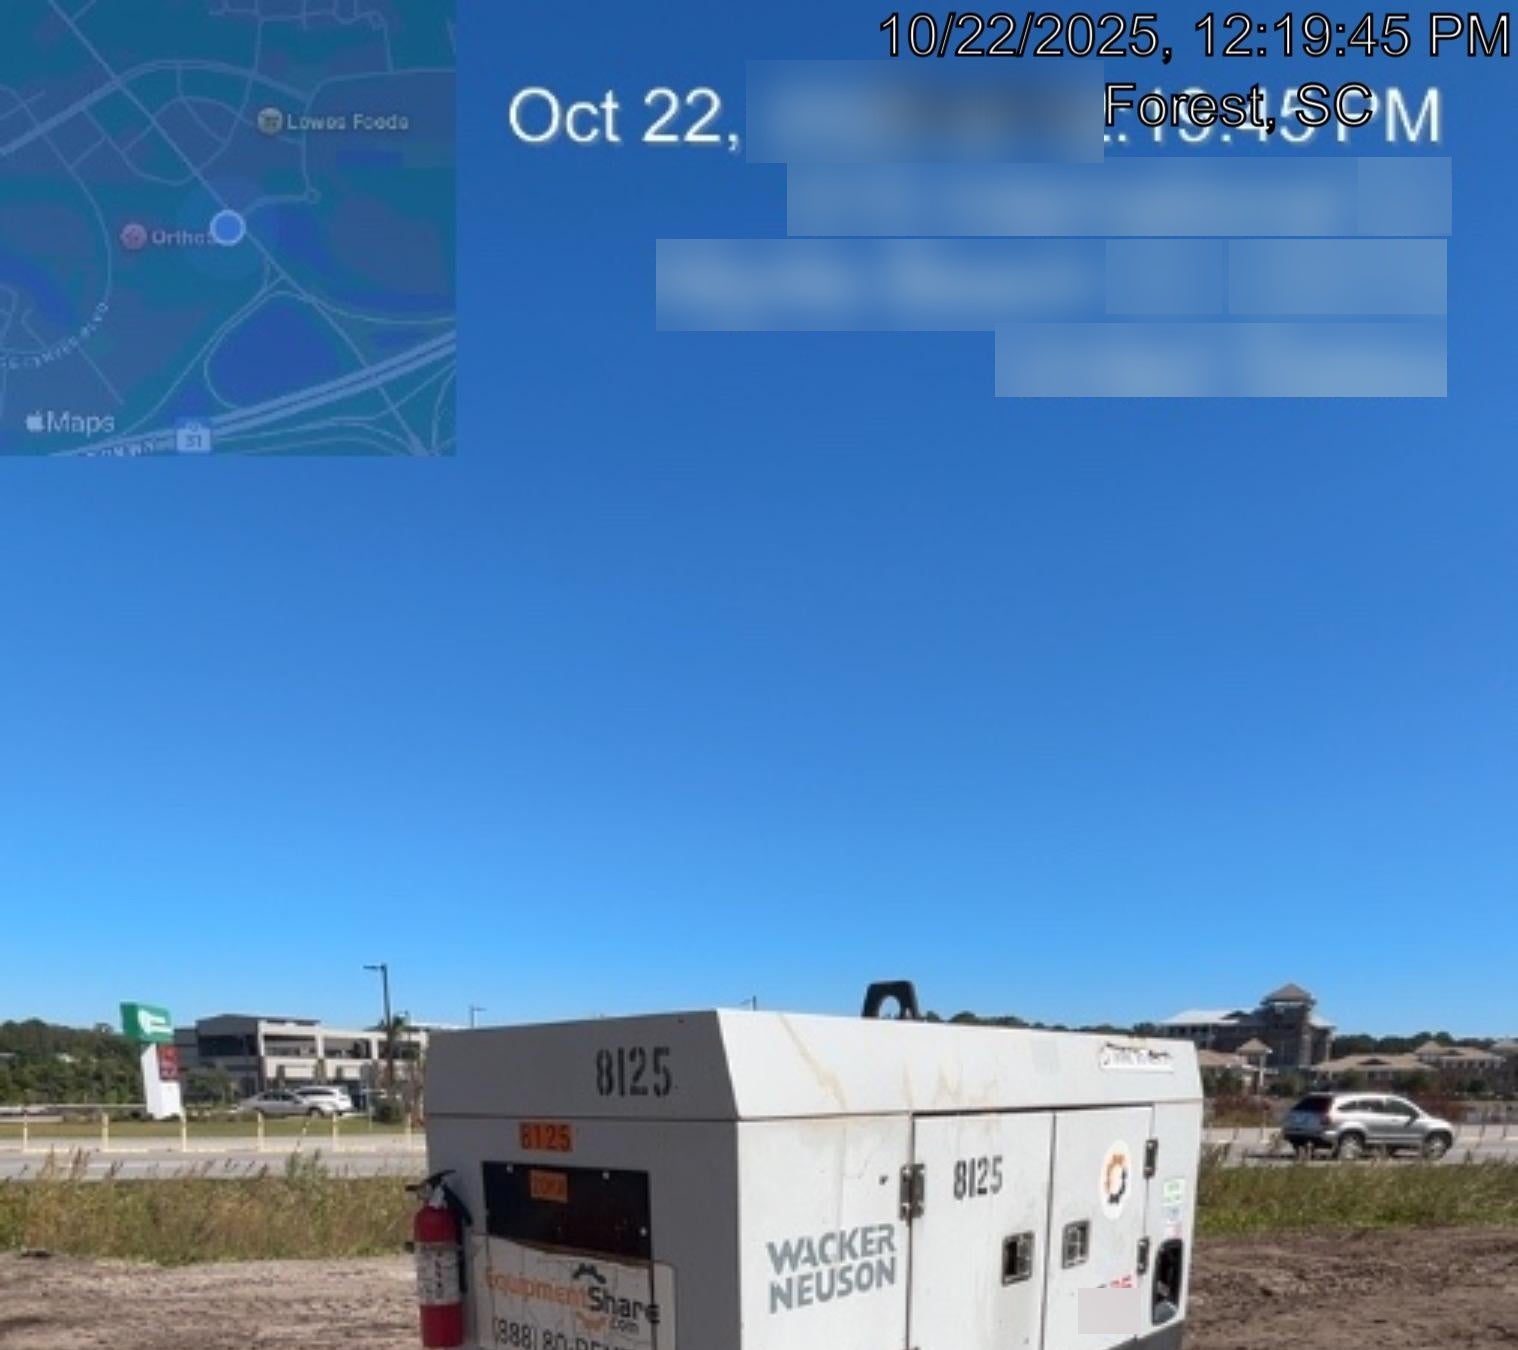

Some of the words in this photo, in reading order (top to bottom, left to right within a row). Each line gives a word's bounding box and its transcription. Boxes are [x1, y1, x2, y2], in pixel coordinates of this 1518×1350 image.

[596, 1045, 673, 1098] 8125
[953, 1155, 1003, 1200] 8125
[767, 1223, 896, 1276] WACKER
[769, 1256, 896, 1314] NEUSON
